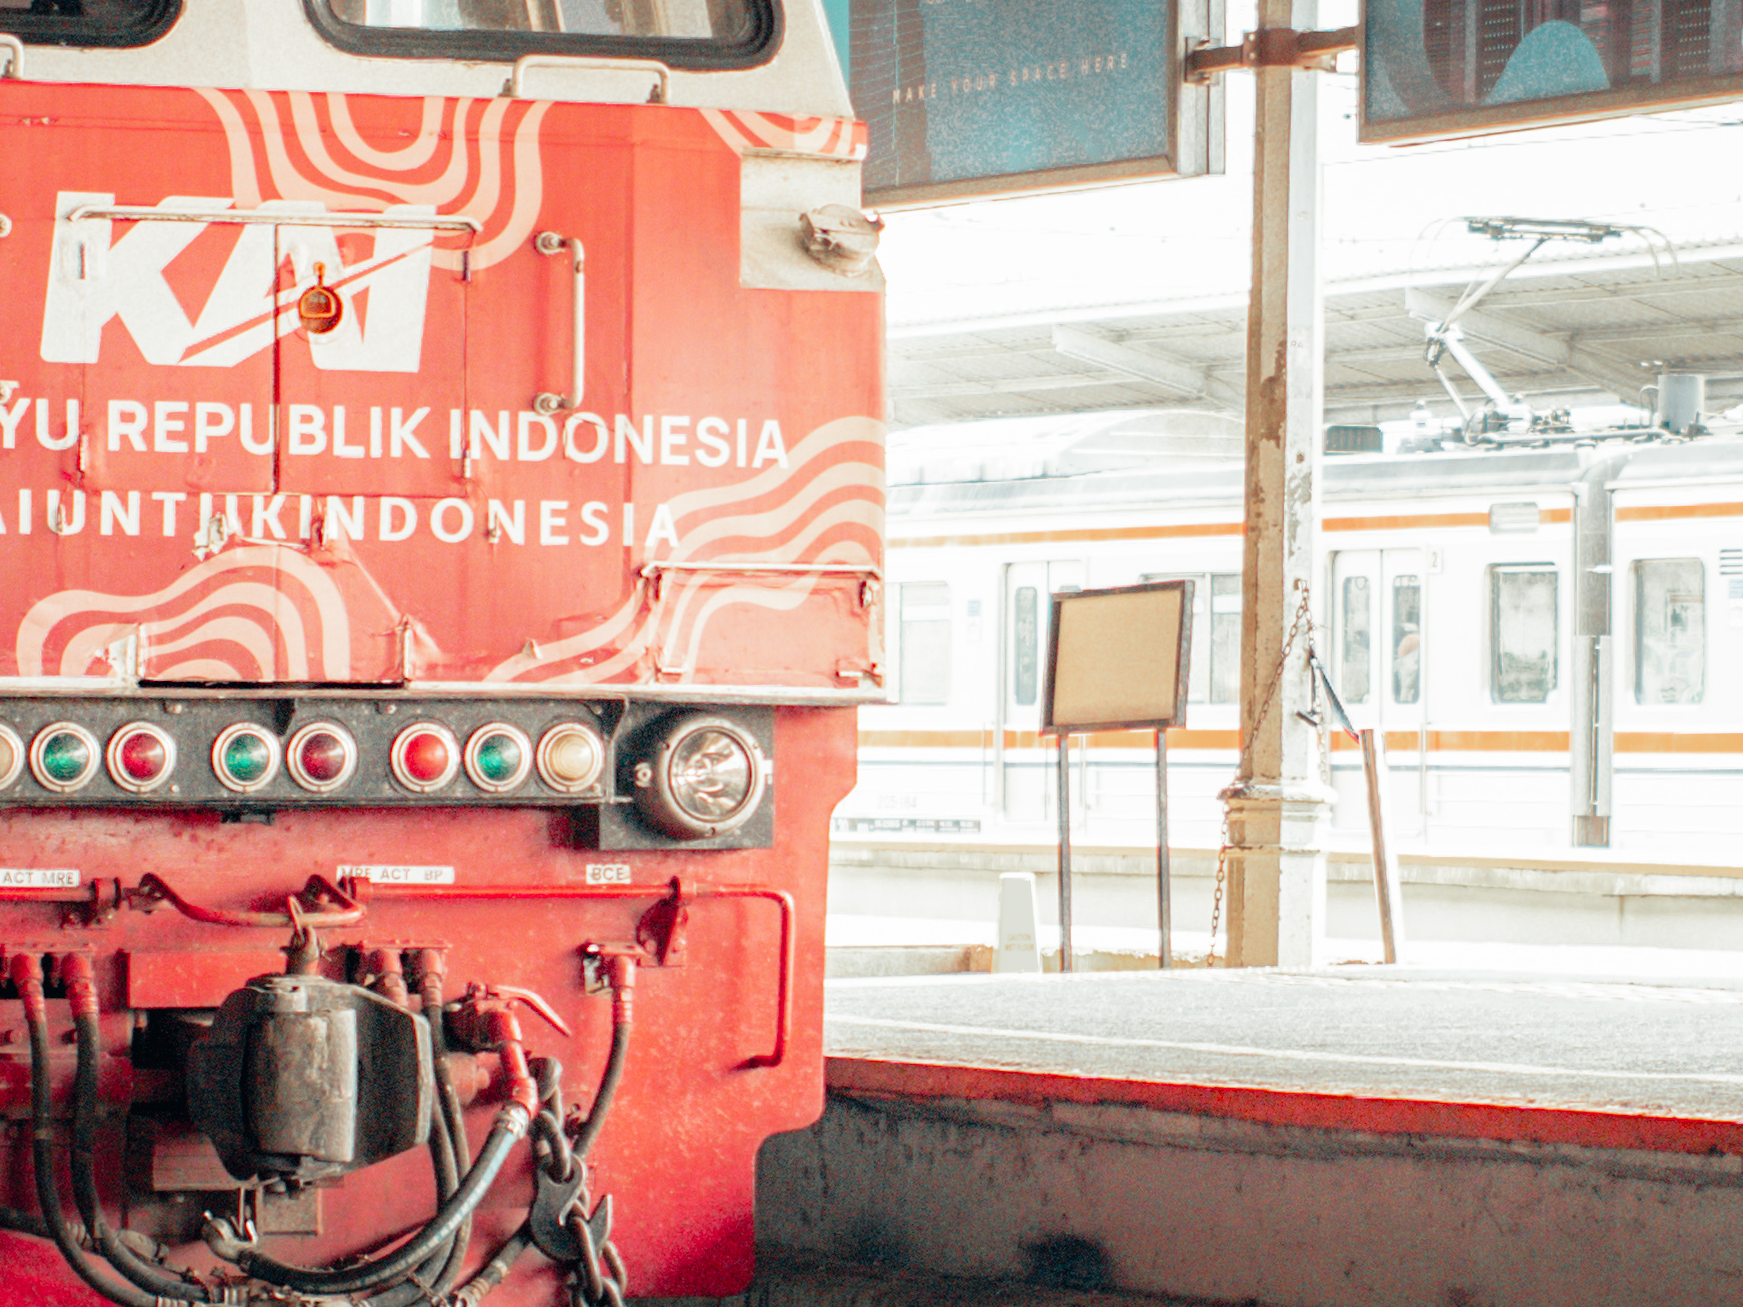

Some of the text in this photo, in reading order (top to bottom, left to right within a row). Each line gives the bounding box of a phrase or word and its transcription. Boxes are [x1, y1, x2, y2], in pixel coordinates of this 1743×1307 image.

[892, 52, 1129, 105] MAKE YOUR SPACE HERE
[39, 190, 436, 374] KAI
[106, 399, 429, 462] REPUBLIK
[450, 407, 789, 470] INDONESIA
[2, 870, 75, 886] ACT MRE
[380, 866, 410, 881] ACT
[423, 868, 444, 882] BP
[591, 866, 626, 882] BCE
